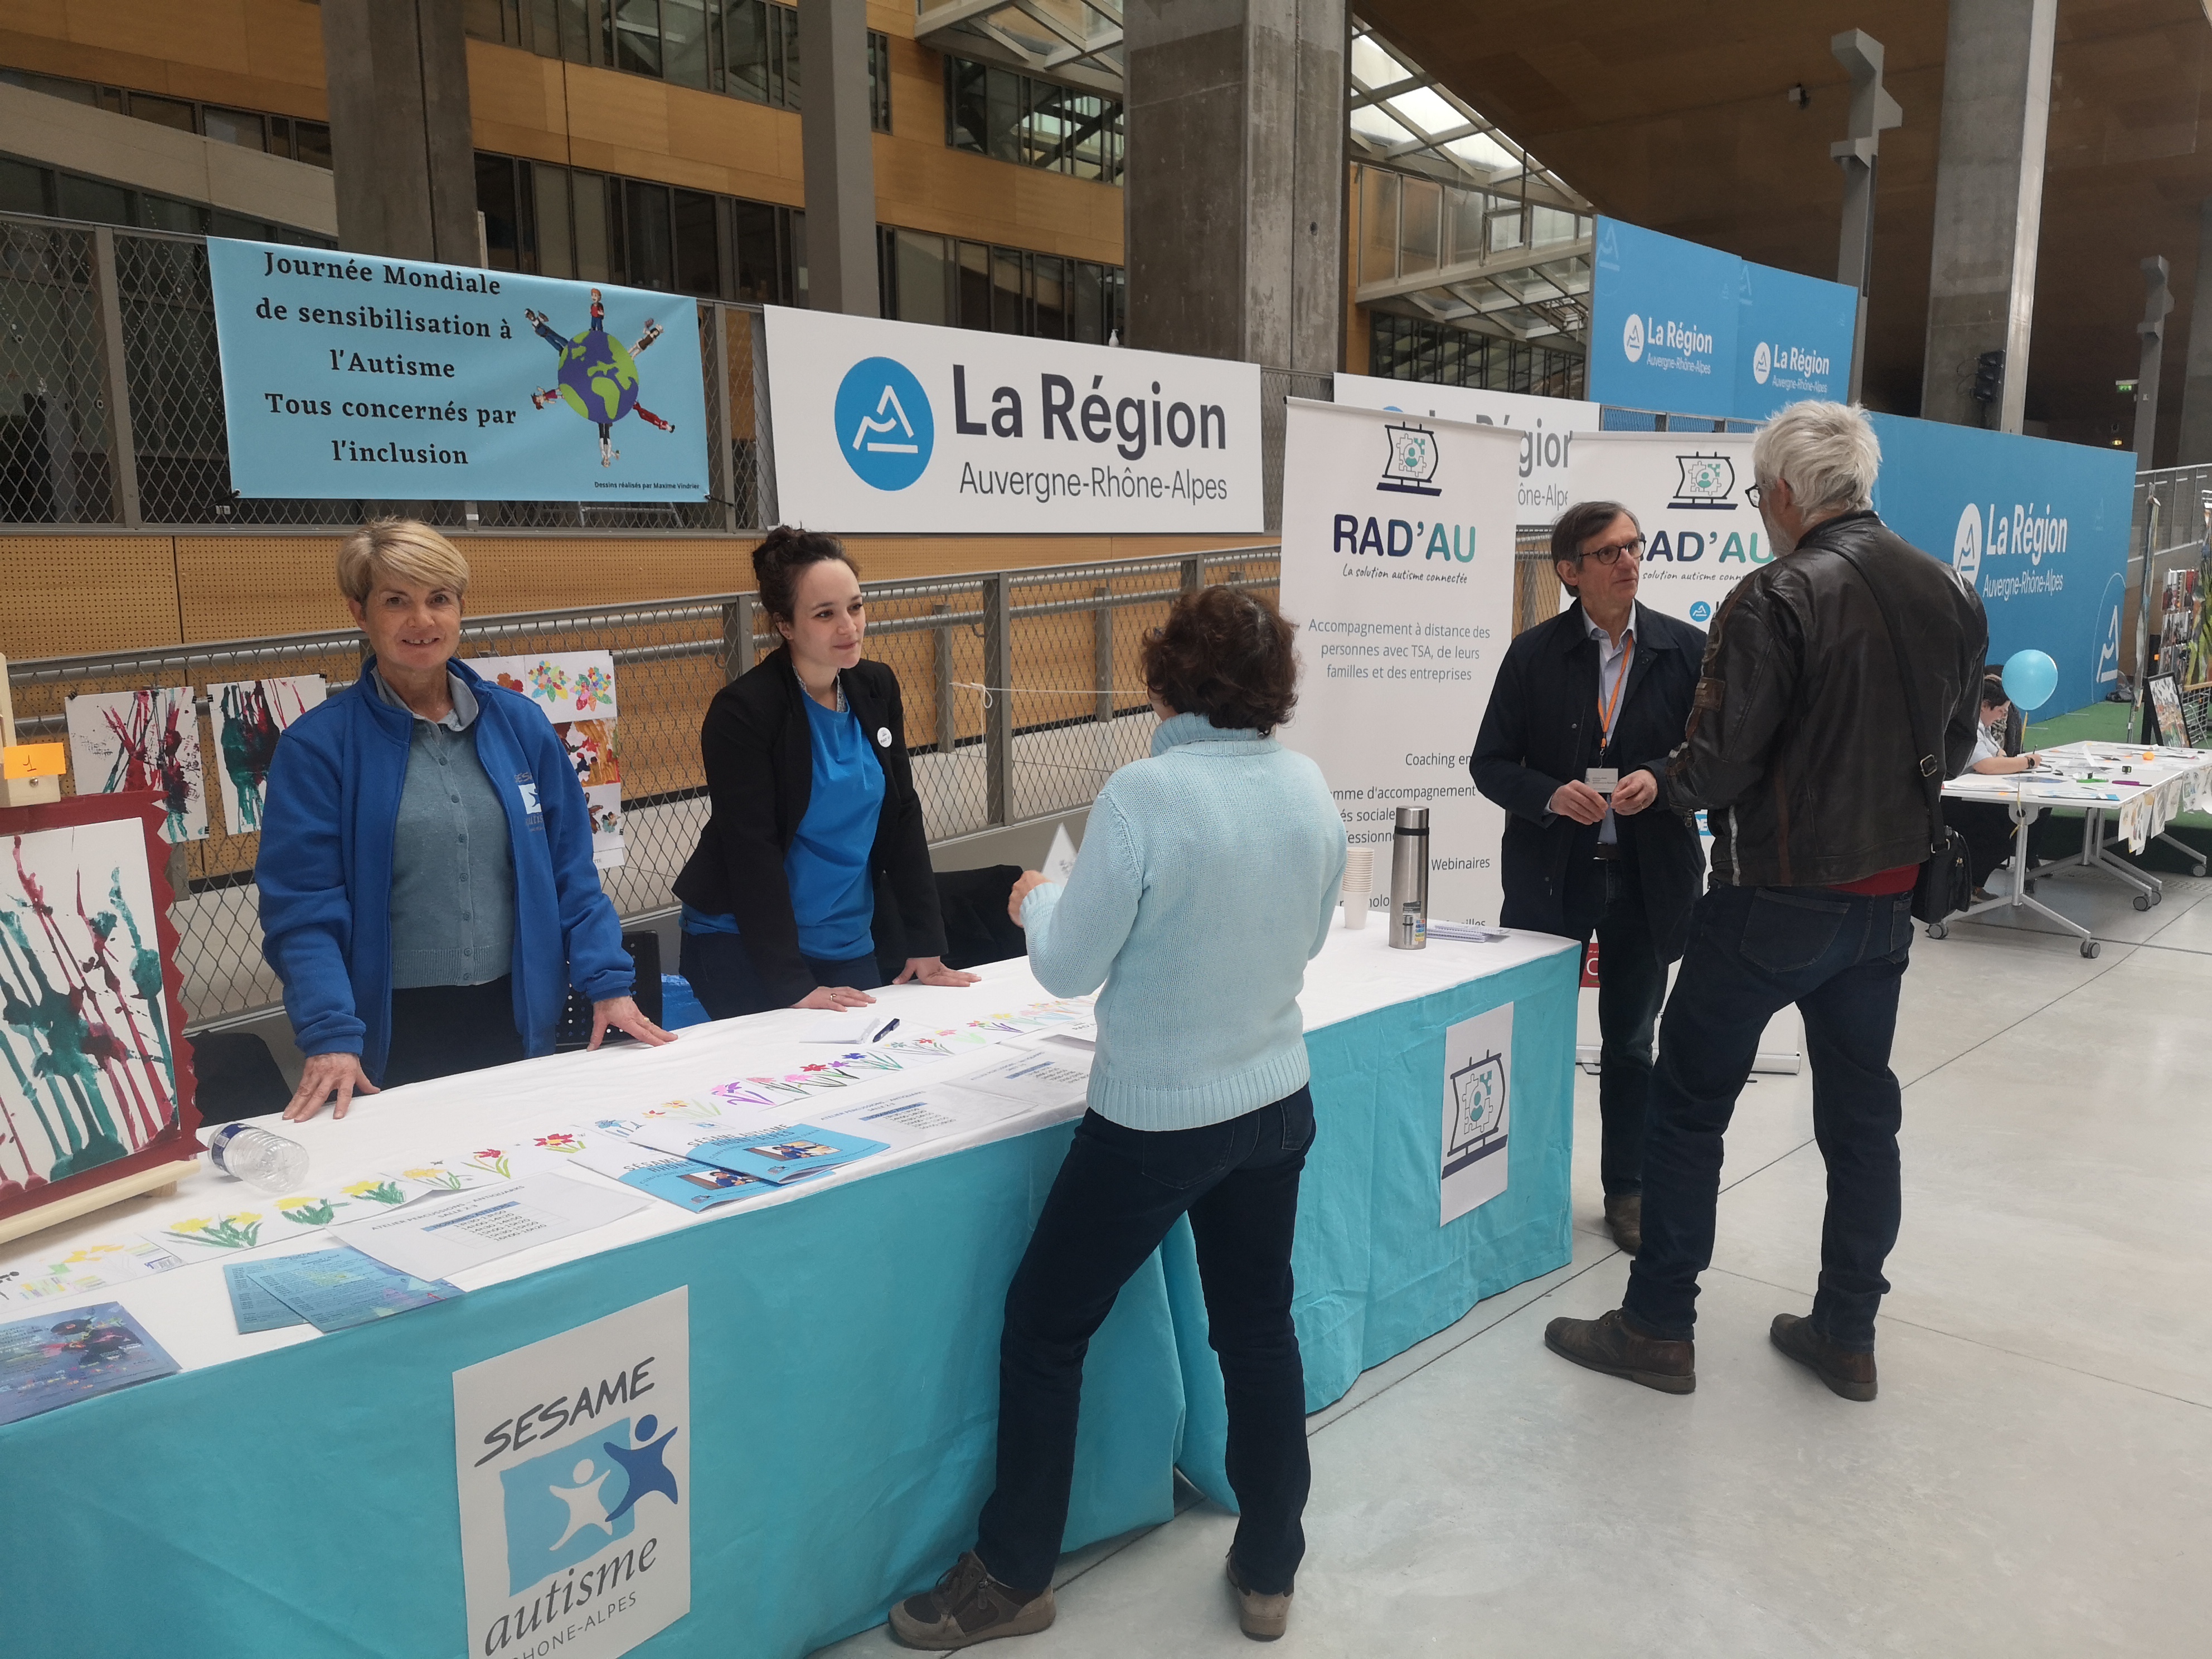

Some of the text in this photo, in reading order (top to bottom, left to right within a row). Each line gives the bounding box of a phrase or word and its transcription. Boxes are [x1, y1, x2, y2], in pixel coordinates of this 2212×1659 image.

[264, 251, 501, 295] Journée Mondiale
[256, 297, 512, 339] de sensibilisation à
[1647, 317, 1713, 356] La Région
[329, 349, 455, 378] l'Autisme
[1647, 352, 1711, 375] Auvergne-Rhône-Alpes
[1773, 344, 1830, 379] La Région
[264, 393, 516, 428] Tous concernés par
[953, 364, 1226, 461] La Région
[331, 440, 468, 464] l'inclusion
[959, 461, 1228, 506] Auvergne-Rhône-Alpes
[1333, 513, 1477, 563] RAD'AU
[1986, 502, 2068, 566] La Région
[1342, 563, 1468, 585] La solution autisme connectée
[1642, 570, 1678, 581] solution
[1681, 572, 1716, 581] autisme
[1982, 568, 2064, 601] Auvergne-Rhône-Alpes
[1308, 618, 1491, 639] Accompagnement à distance des
[1321, 644, 1479, 659] personnes avec TSA, de leurs
[1327, 664, 1472, 683] familles et des entreprises
[1405, 753, 1455, 769] Coaching
[1367, 785, 1476, 802] d'accompagnement
[1356, 807, 1395, 822] sociale
[1431, 857, 1490, 871] Webinaires
[743, 1123, 791, 1138] AUTISME
[623, 1156, 682, 1172] SÉSAME
[371, 1220, 406, 1231] ATELIER
[407, 1203, 465, 1223] PERCUSSIONS
[472, 1185, 525, 1203] ANTIQUARKS
[437, 1207, 464, 1219] SALLE
[474, 1356, 656, 1467] SESAME
[484, 1537, 658, 1657] autisme
[512, 1591, 637, 1659] HONE-ALPES
